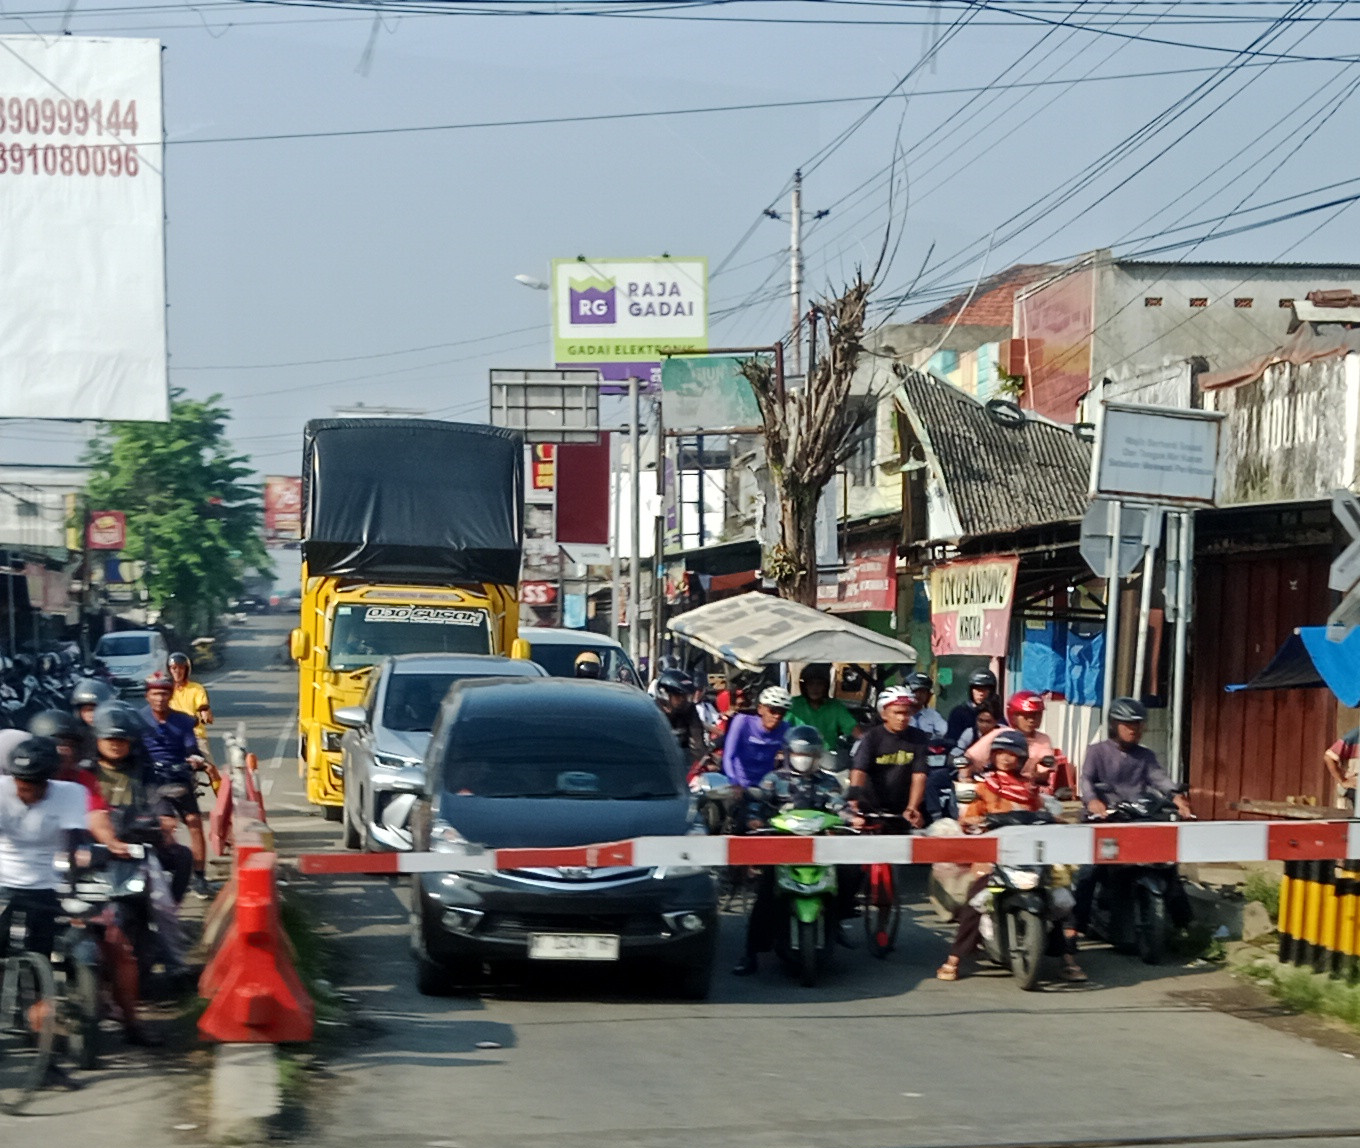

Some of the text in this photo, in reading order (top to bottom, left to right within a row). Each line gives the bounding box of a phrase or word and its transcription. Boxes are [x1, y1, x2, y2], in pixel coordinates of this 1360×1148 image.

[627, 281, 681, 298] RAJA
[578, 299, 608, 316] RG
[628, 301, 694, 317] GADAI
[567, 344, 611, 356] GADAI
